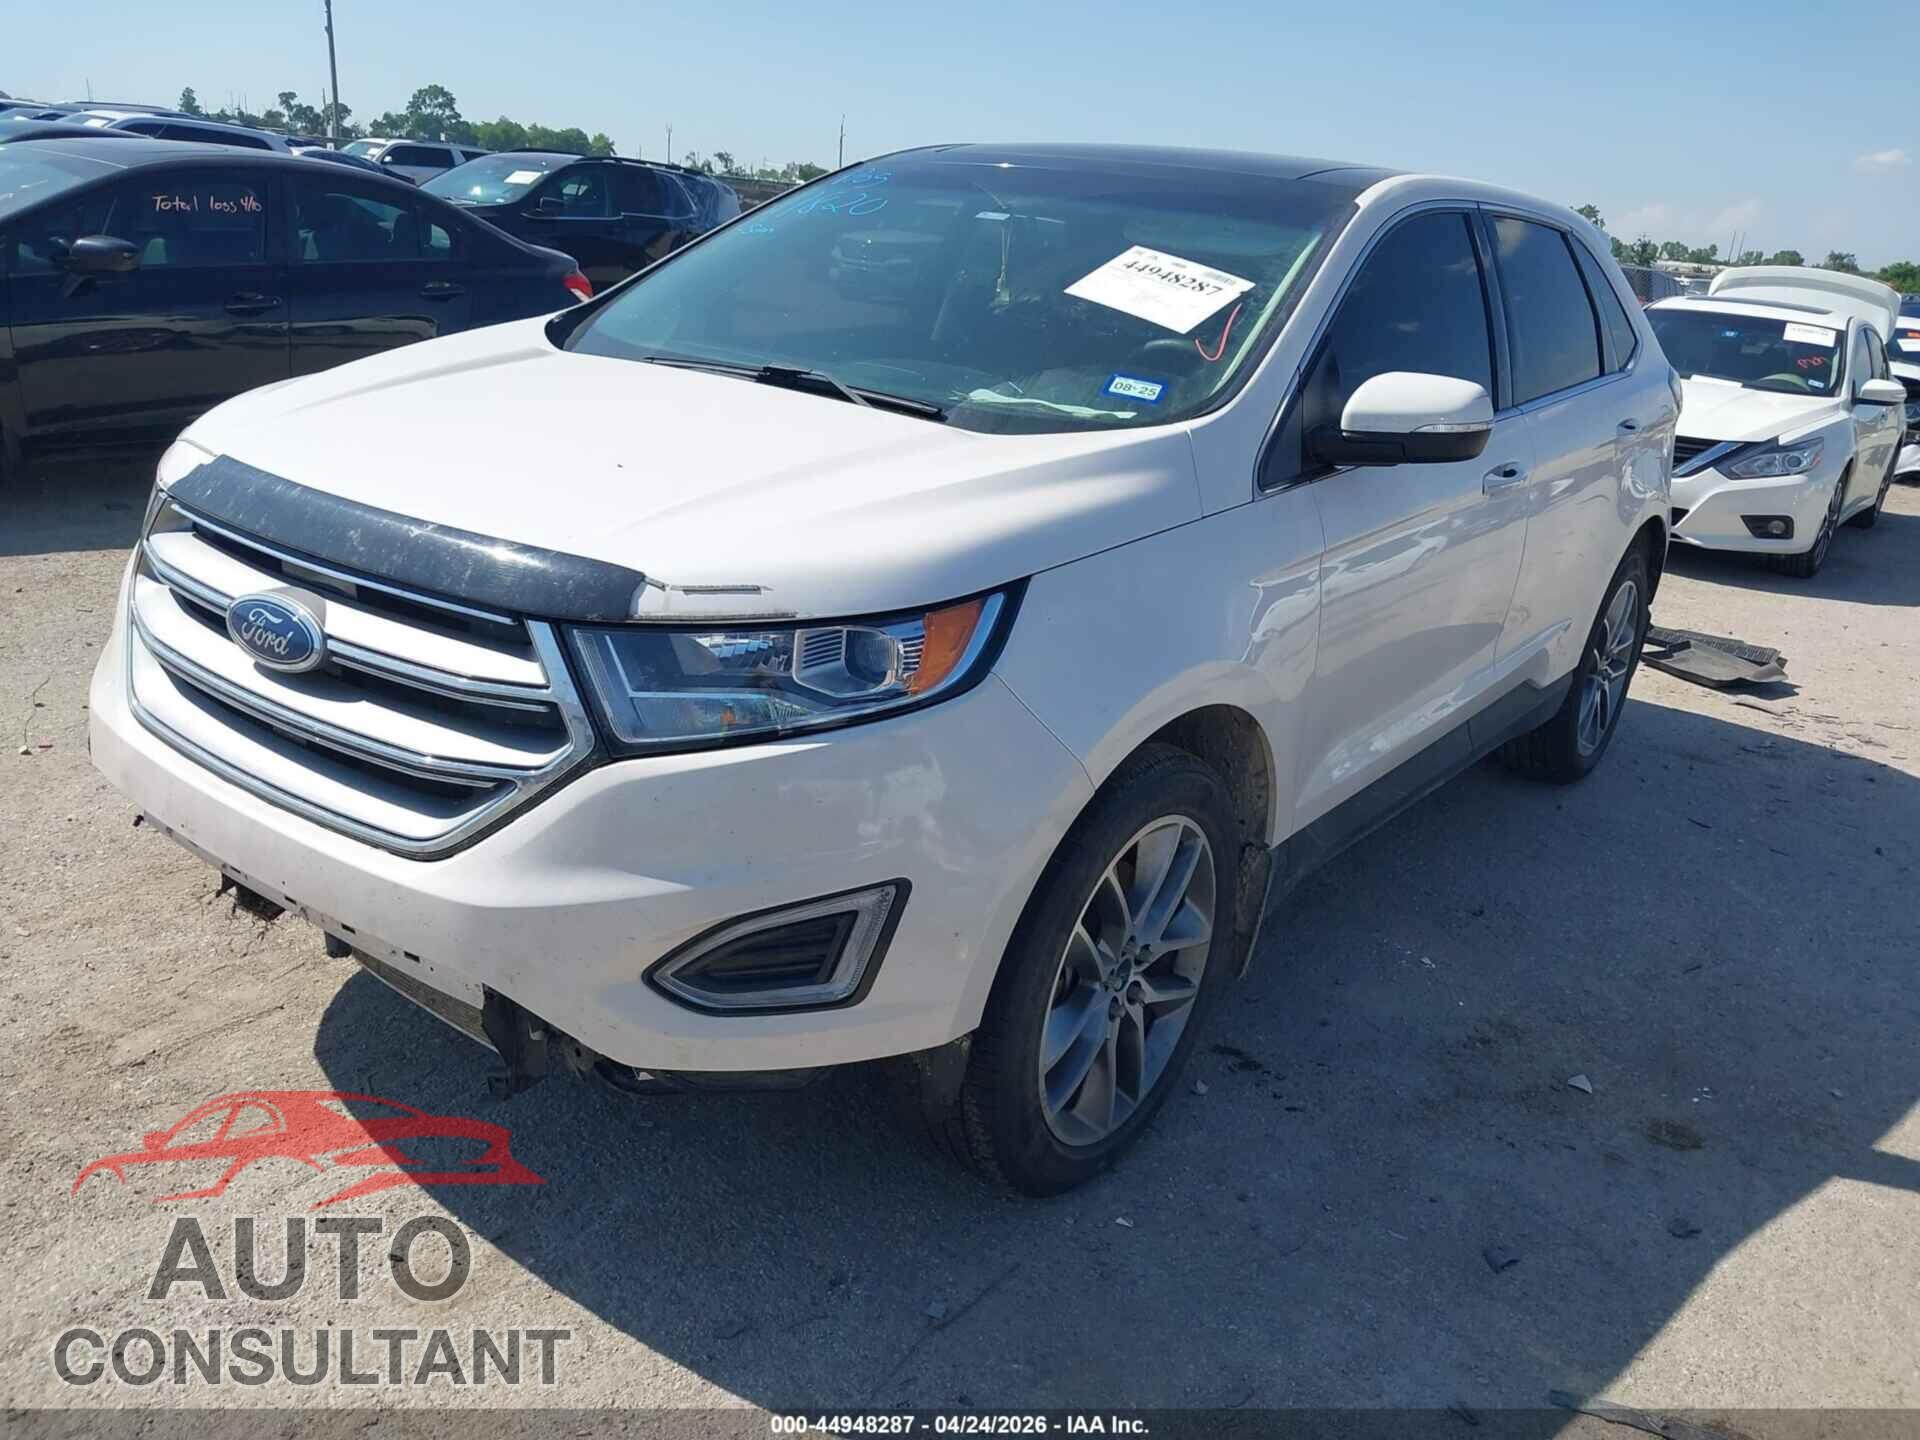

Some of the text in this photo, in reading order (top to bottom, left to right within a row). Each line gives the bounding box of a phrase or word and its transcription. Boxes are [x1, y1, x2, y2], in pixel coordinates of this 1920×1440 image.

[152, 194, 199, 212] Total
[209, 195, 238, 213] loss
[1122, 260, 1223, 296] 44948287
[240, 607, 295, 656] Ford
